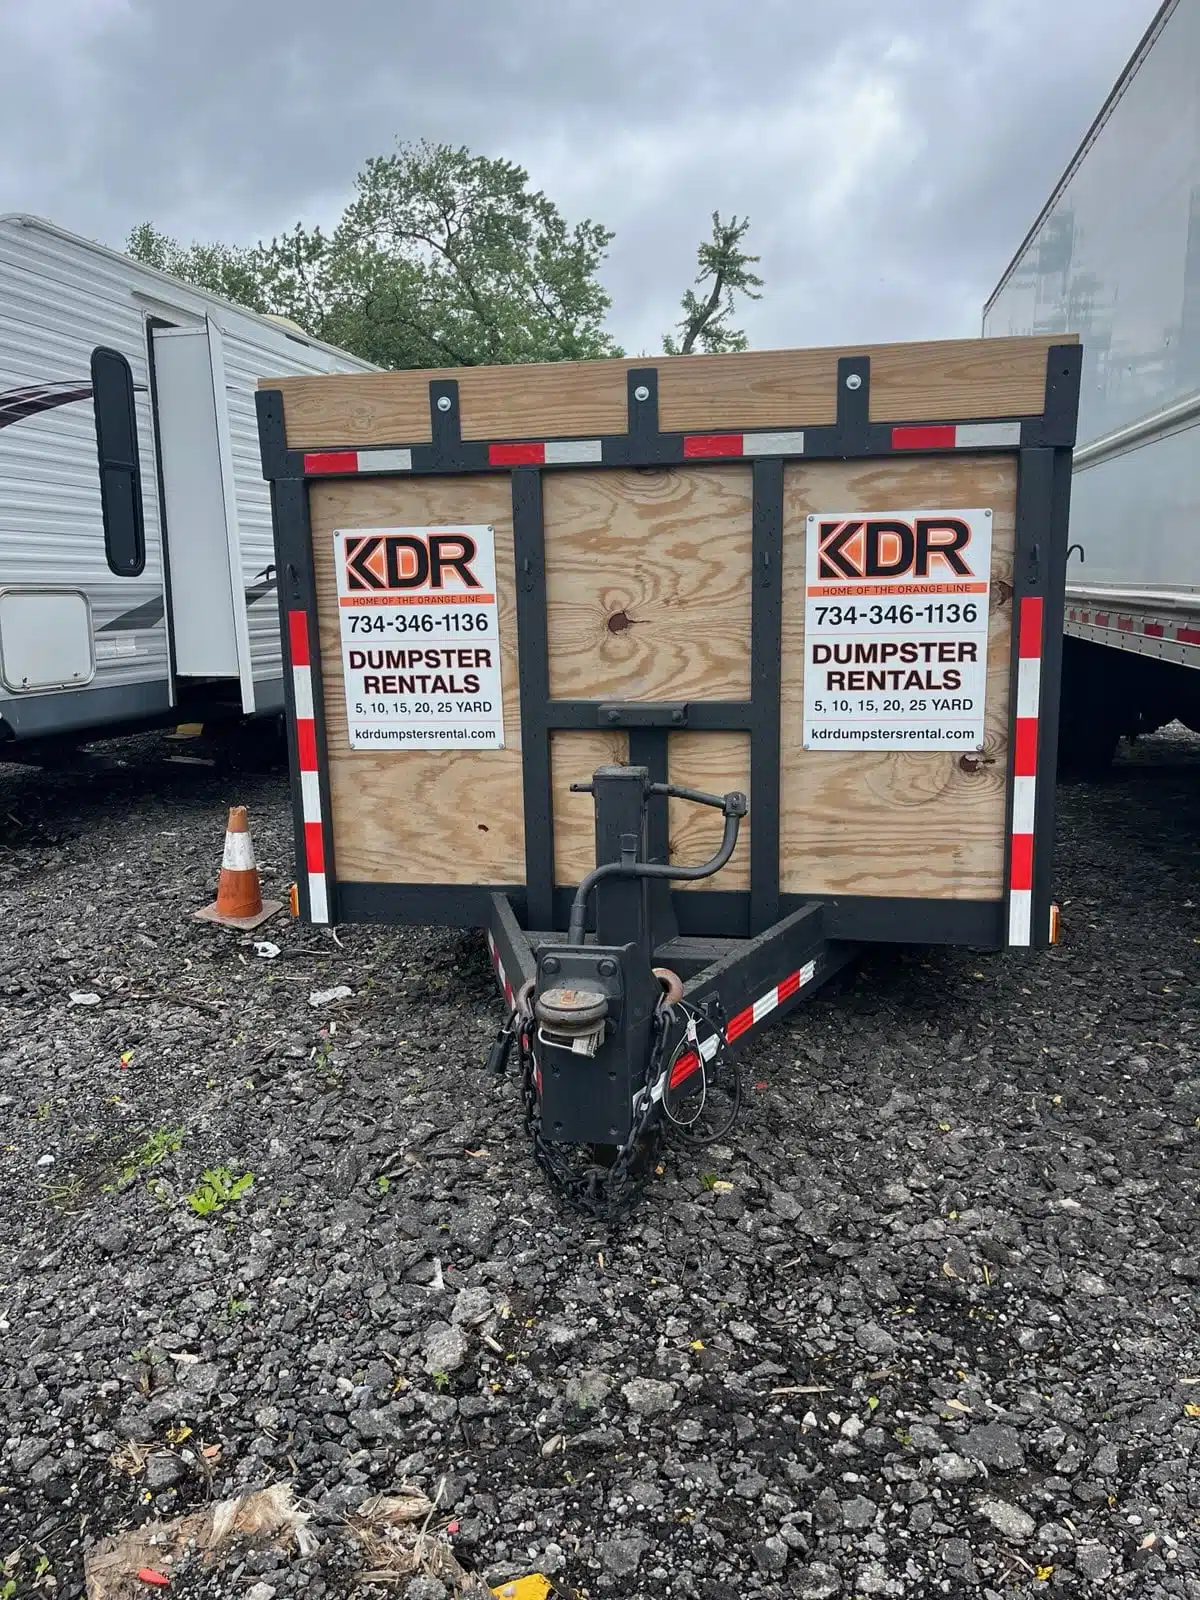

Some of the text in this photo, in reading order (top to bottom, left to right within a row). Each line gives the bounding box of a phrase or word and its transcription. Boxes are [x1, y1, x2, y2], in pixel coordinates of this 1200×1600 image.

[818, 516, 975, 580] KDR
[344, 533, 483, 591] KDR
[822, 583, 971, 596] HOME OF THE ORANGE LINE
[352, 594, 481, 606] HOME OF THE ORANGE LINE
[348, 613, 489, 633] 734-346-1136
[815, 603, 977, 625] 734-346-1136
[349, 649, 492, 669] DUMPSTER
[812, 642, 977, 664] DUMPSTER
[364, 674, 480, 694] RENTALS
[827, 669, 962, 691] RENTALS
[355, 701, 492, 715] 5, 10, 15, 20, 25 YARD
[814, 698, 973, 713] 5, 10, 15, 20, 25 YARD
[355, 728, 496, 741] kdrdumpstersrental.com
[811, 728, 975, 741] kdrdumpstersrental.com
